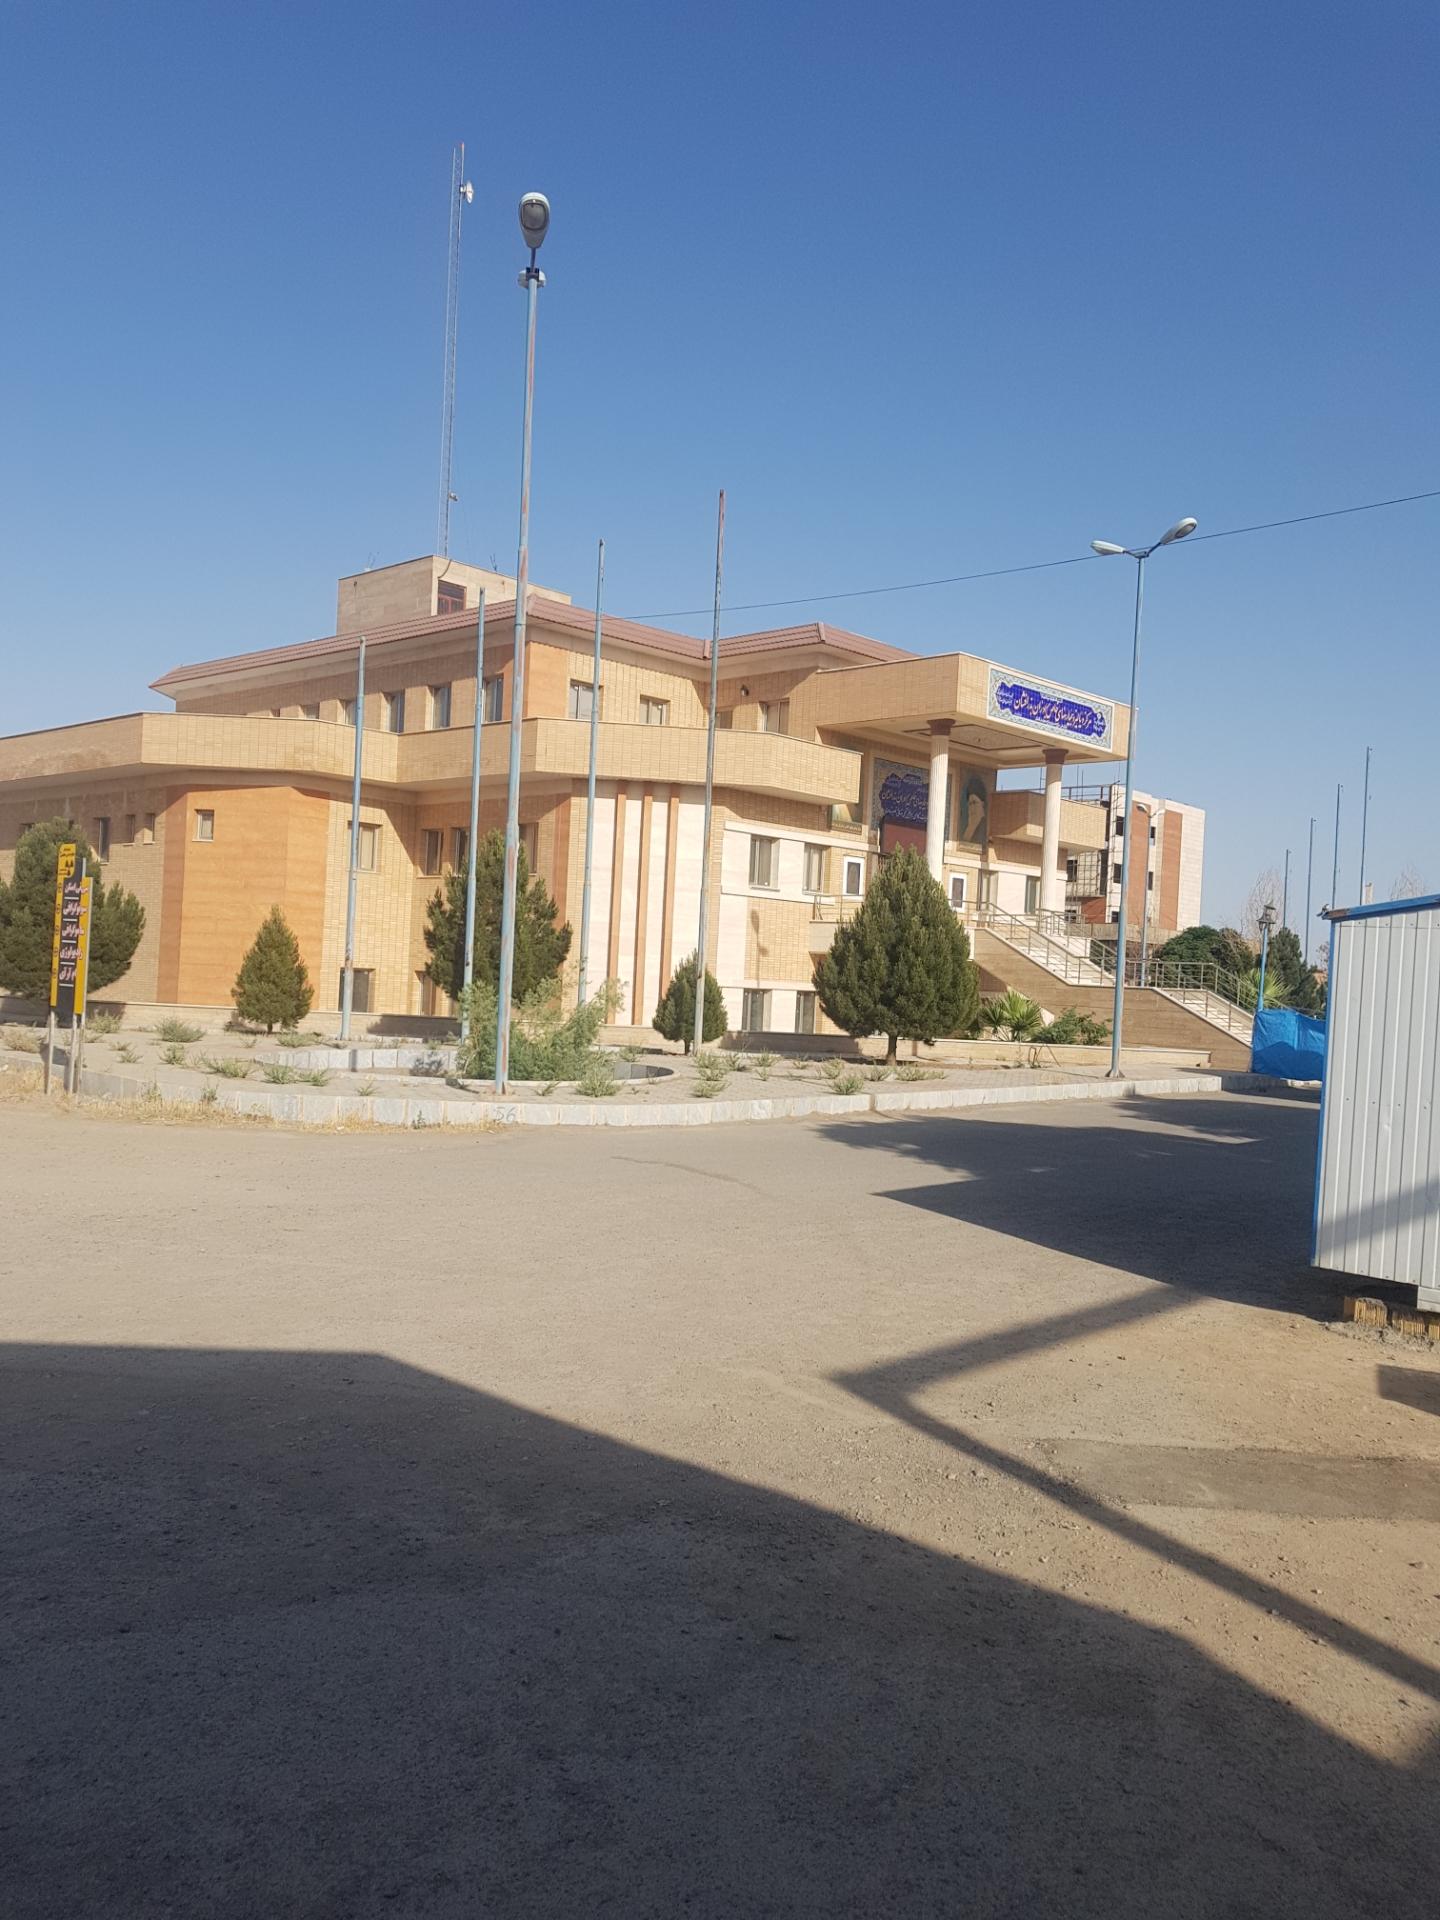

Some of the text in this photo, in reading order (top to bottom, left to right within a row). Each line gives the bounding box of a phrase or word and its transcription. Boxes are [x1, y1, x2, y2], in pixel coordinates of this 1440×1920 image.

[62, 902, 87, 916] سونوگرافی
[61, 924, 85, 937] ماموگرافی
[59, 946, 83, 960] رادیولوژی
